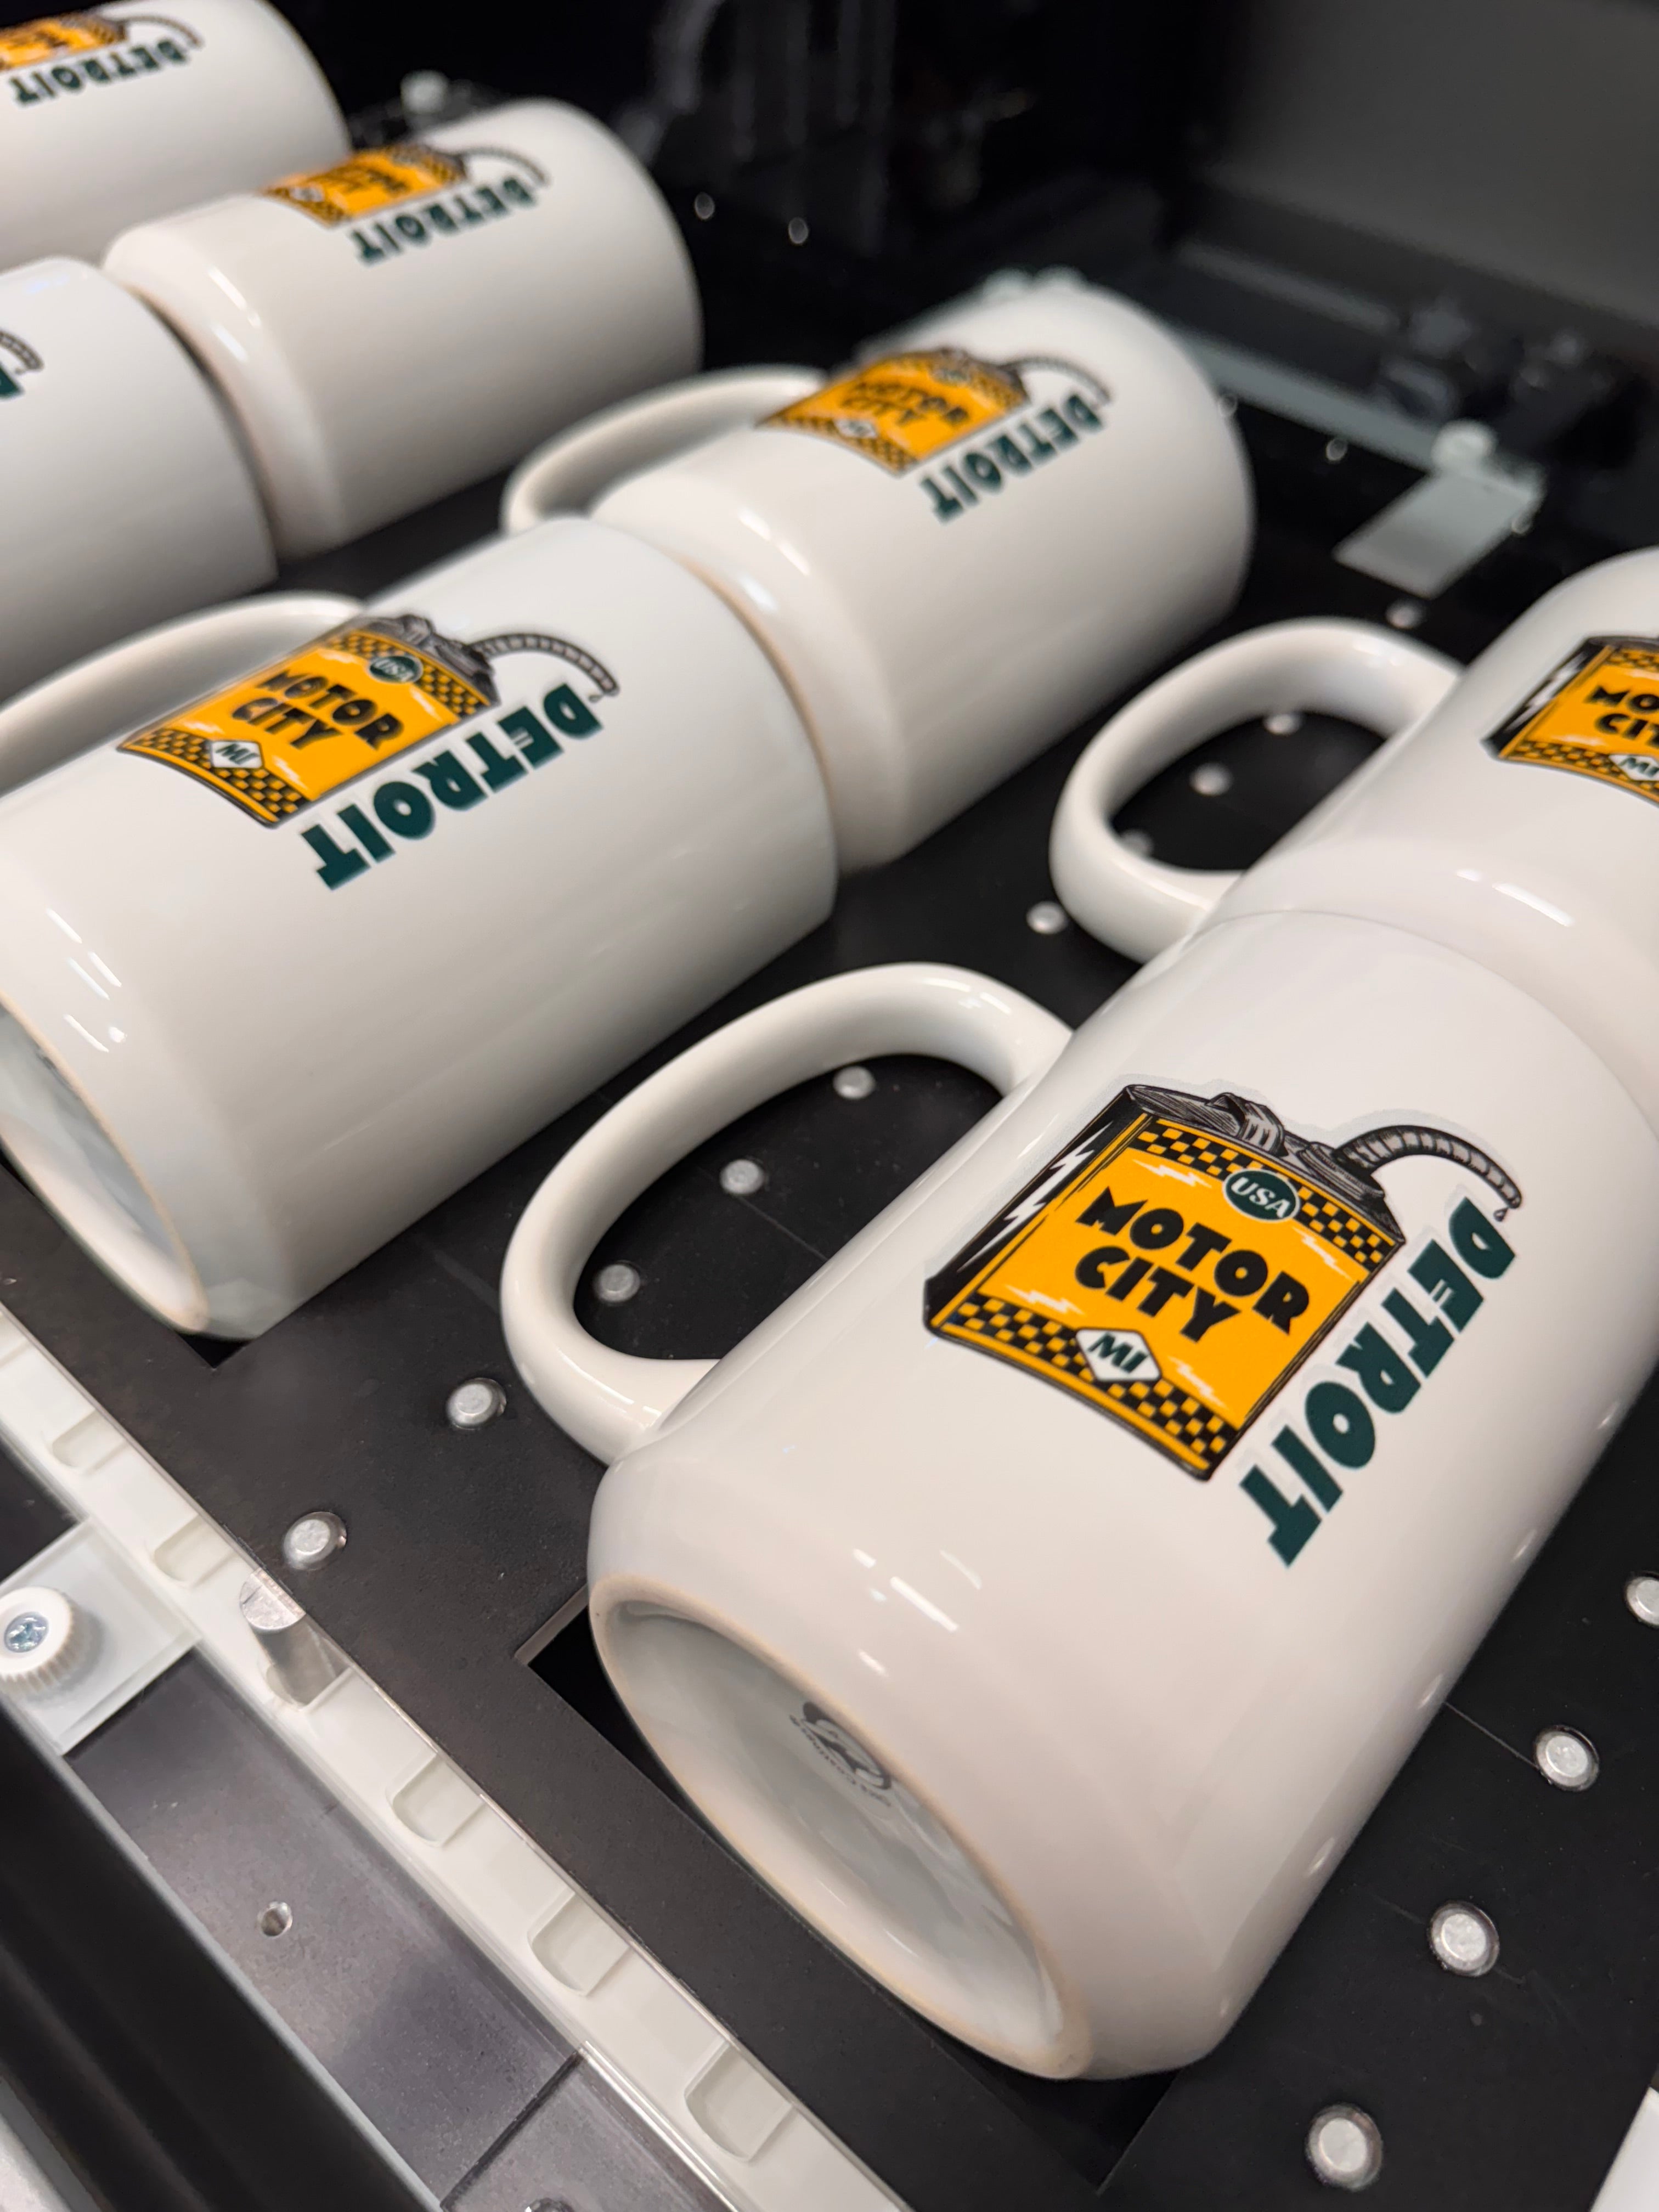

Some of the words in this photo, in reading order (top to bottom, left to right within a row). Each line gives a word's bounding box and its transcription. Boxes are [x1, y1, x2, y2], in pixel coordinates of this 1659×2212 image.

[9, 38, 188, 104] DETROIT
[350, 175, 535, 265] DETROIT
[919, 392, 1104, 522] DETROIT
[232, 697, 343, 749] CITY
[256, 669, 405, 751] MOTOR
[216, 743, 259, 765] MI
[300, 682, 604, 890] DETROIT
[1231, 1177, 1292, 1218] USA
[1075, 1186, 1310, 1336] MOTOR
[1075, 1246, 1242, 1344] CITY
[1087, 1333, 1149, 1374] MI
[1239, 1196, 1516, 1568] DETROIT
